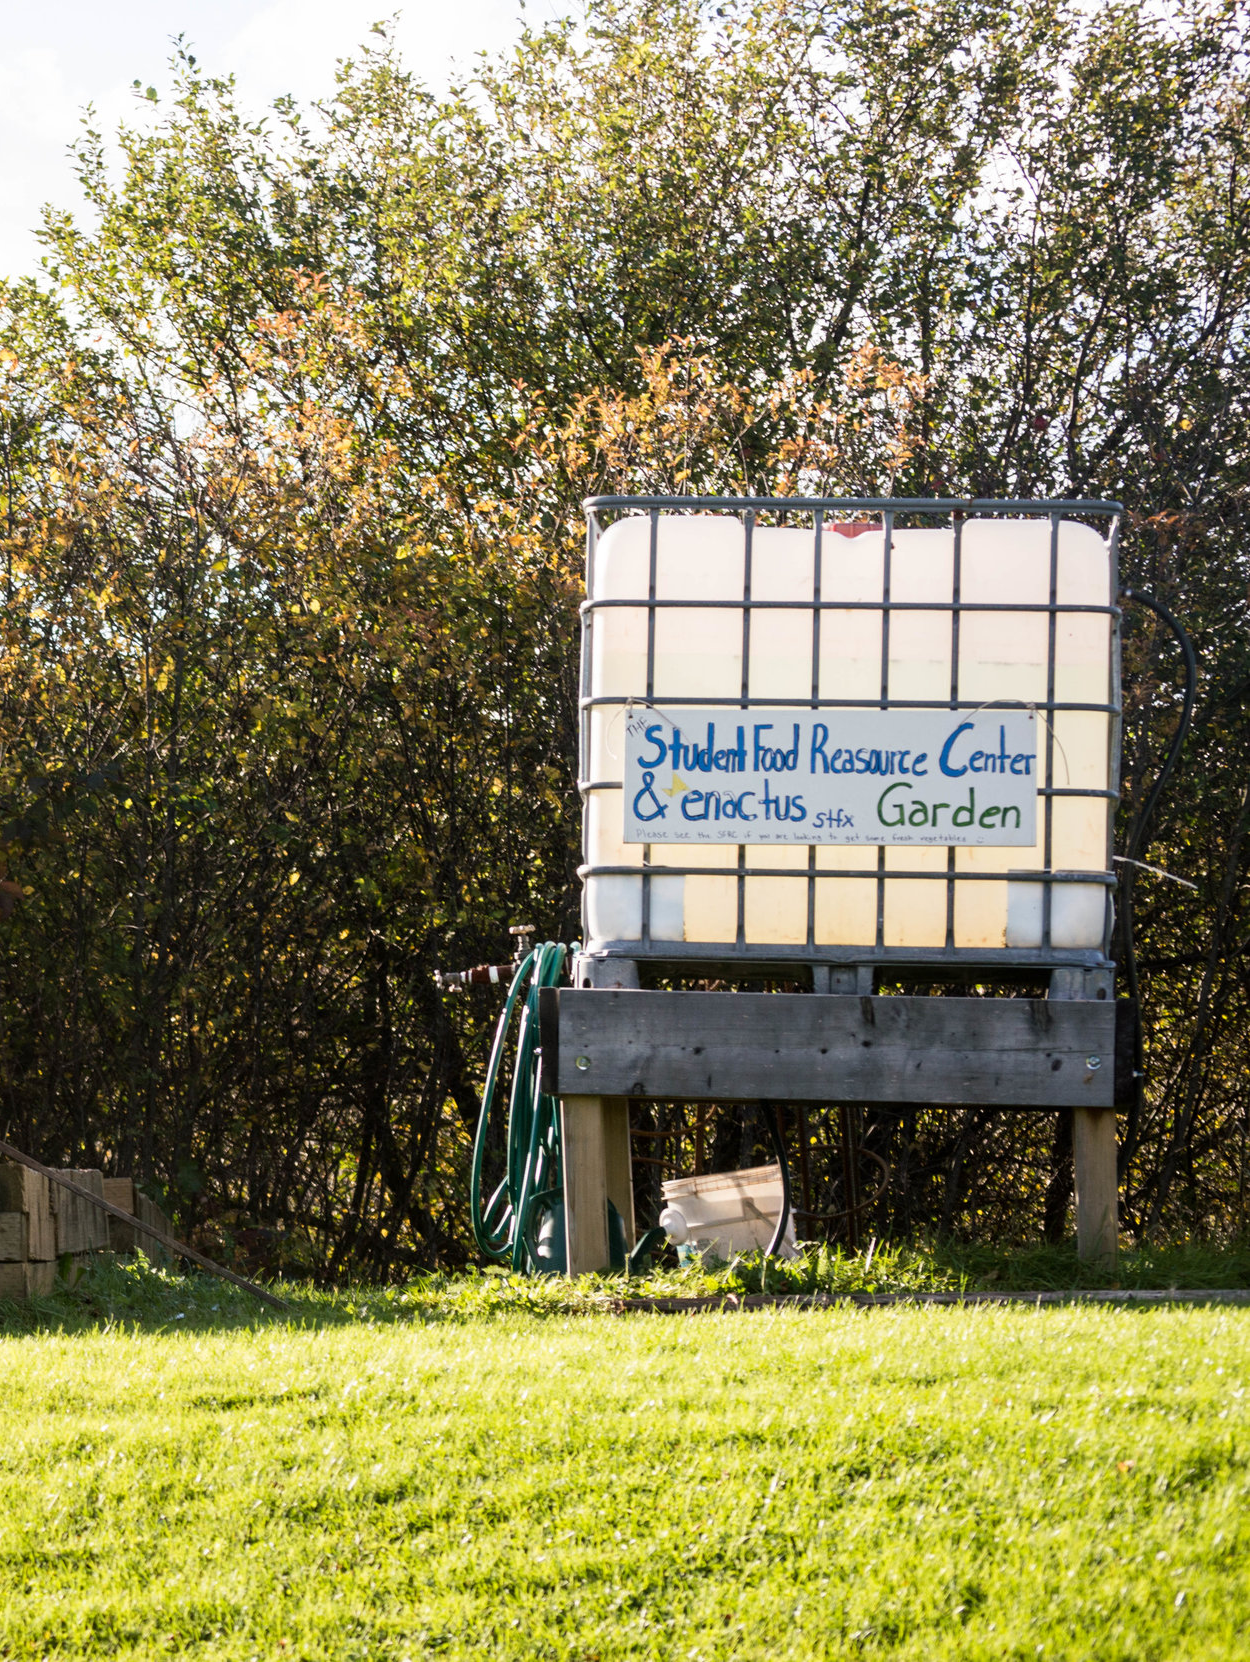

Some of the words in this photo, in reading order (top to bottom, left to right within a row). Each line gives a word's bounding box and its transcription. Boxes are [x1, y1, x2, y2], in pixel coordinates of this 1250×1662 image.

[637, 722, 747, 773] Student
[753, 723, 800, 773] Food
[811, 723, 928, 776] Reasource
[939, 722, 1037, 778] Center
[633, 771, 669, 822] &
[681, 779, 807, 822] enactus
[877, 782, 1021, 829] Garden
[636, 828, 668, 839] Please
[674, 831, 691, 839] see
[698, 831, 710, 840] the
[744, 830, 752, 839] if
[759, 833, 770, 841] you
[794, 832, 822, 842] looking
[829, 832, 837, 840] to
[845, 833, 860, 843] get
[892, 834, 914, 842] fresh
[920, 834, 966, 843] vegetables
